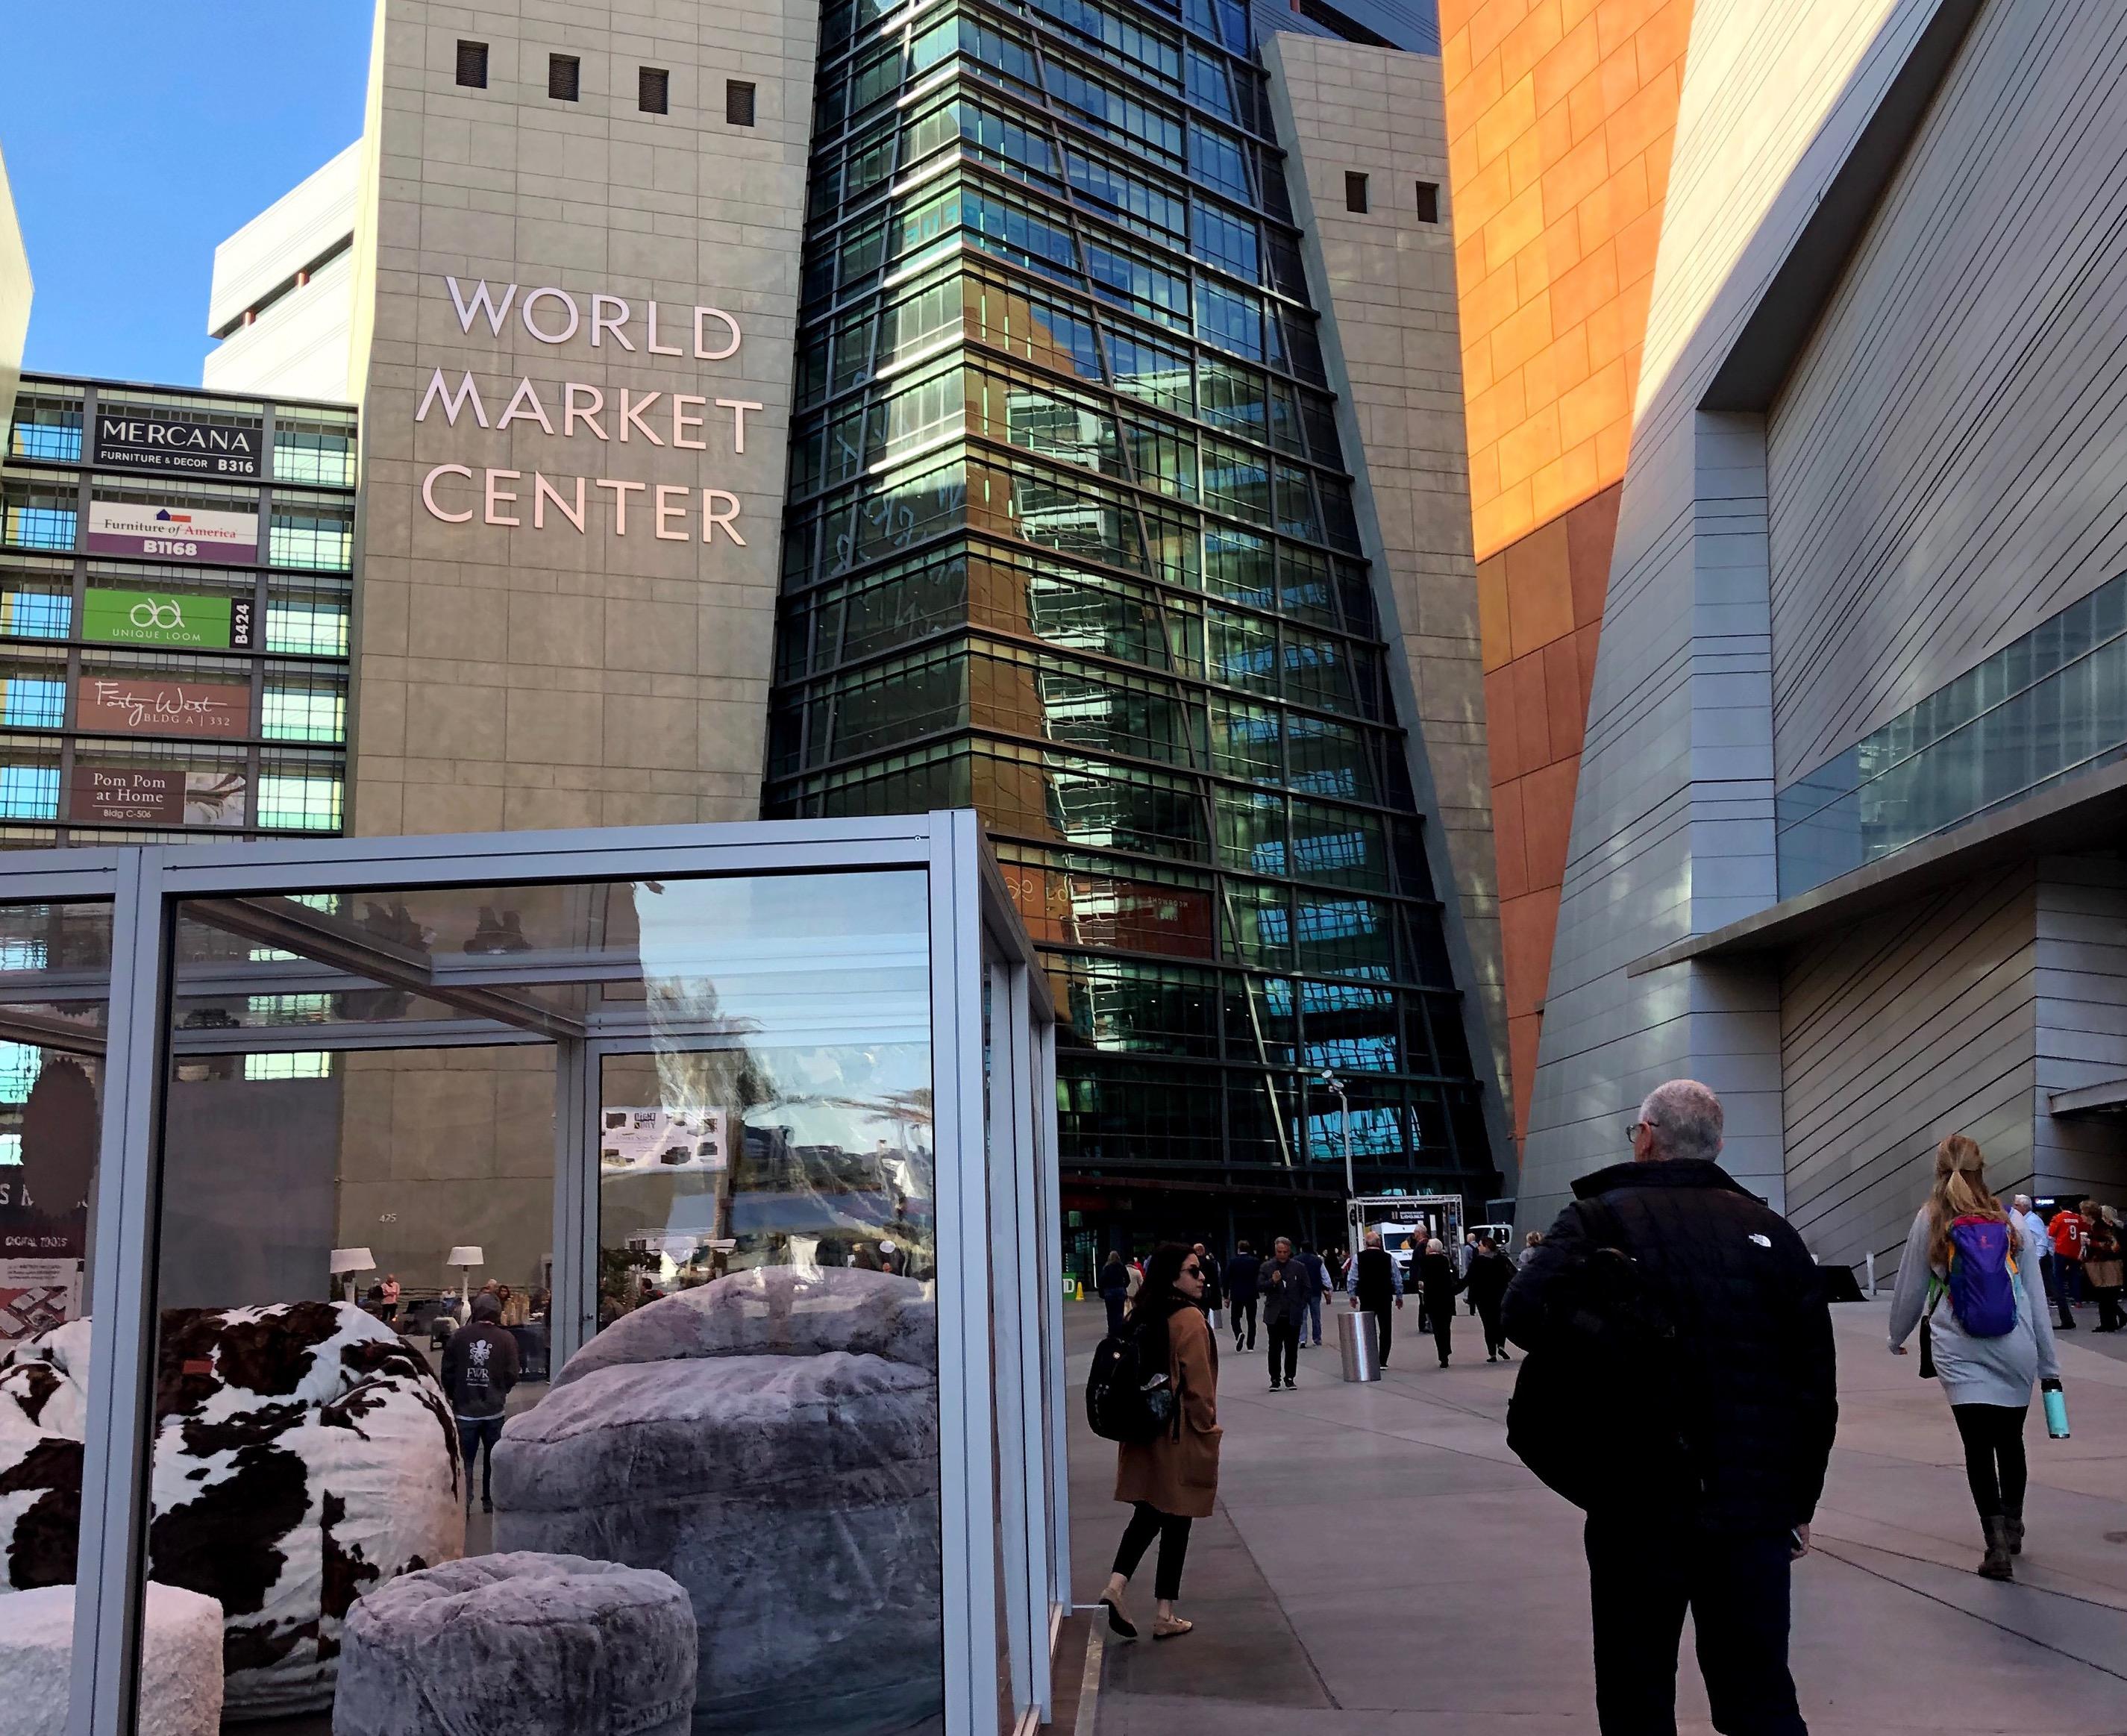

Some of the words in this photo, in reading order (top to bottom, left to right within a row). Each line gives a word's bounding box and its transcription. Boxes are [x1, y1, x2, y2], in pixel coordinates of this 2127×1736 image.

[445, 276, 742, 360] WORLD
[415, 366, 763, 454] MARKET
[103, 420, 250, 452] MERCANA
[101, 451, 162, 463] FURNITURE
[173, 457, 208, 468] DECOR
[218, 459, 254, 473] B316
[421, 463, 747, 546] CENTER
[104, 519, 165, 533] Furniture
[168, 524, 182, 536] of
[184, 526, 236, 538] America
[143, 539, 198, 556] B1168
[234, 604, 250, 645] B424
[113, 628, 159, 639] UNIQUE
[166, 632, 201, 642] LOOM
[95, 680, 154, 727] Forty
[155, 687, 228, 714] West
[144, 714, 180, 724] BLDG
[186, 715, 194, 724] A
[93, 773, 126, 787] Pom
[134, 774, 166, 789] Pom
[96, 791, 110, 801] at
[118, 789, 163, 803] Home
[103, 809, 124, 819] Bldg
[126, 809, 151, 818] C-506
[2070, 1225, 2077, 1240] 9
